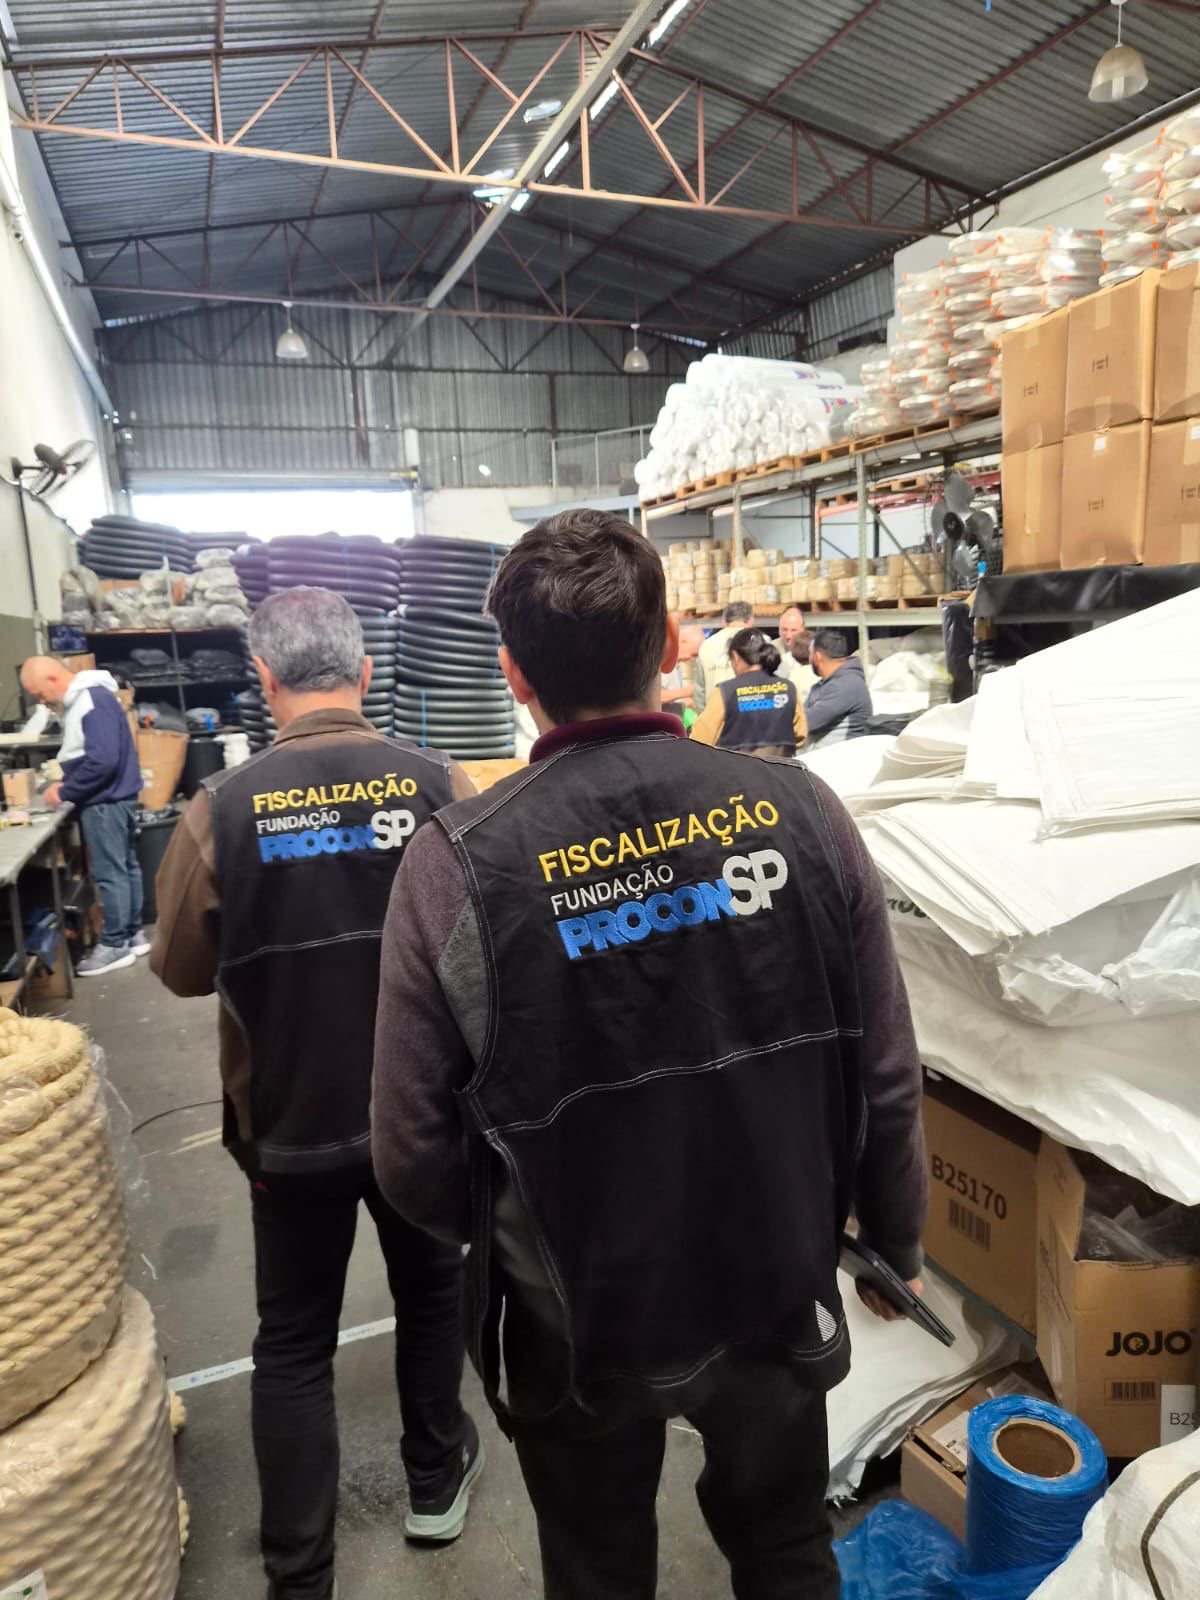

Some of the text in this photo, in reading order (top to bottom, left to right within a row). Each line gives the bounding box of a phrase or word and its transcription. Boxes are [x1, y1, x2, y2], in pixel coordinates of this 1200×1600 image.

[252, 773, 418, 814] FISCALIZAÇÃO
[256, 807, 341, 834] FUNDAÇÃO
[538, 794, 780, 883] FISCALIZAÇÃO
[550, 861, 674, 916] FUNDAÇÃO
[931, 1155, 1007, 1220] B25170
[1104, 1330, 1192, 1357] JOJO
